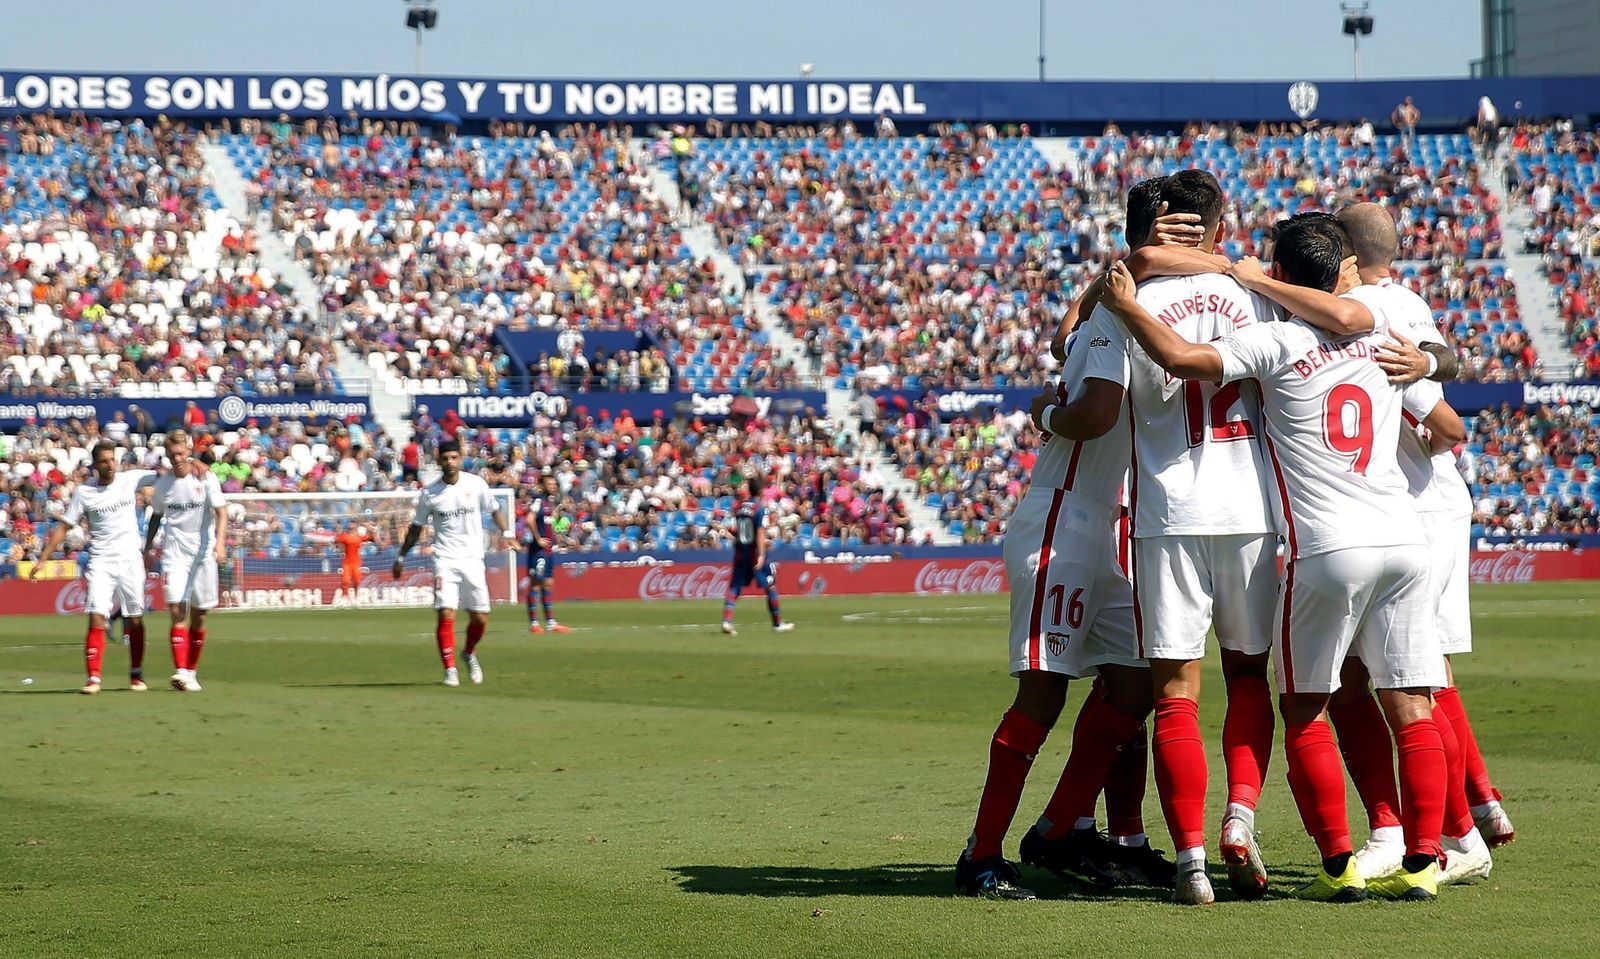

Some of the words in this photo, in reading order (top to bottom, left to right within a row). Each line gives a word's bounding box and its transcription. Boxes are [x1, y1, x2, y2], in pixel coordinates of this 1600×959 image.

[144, 77, 235, 110] SON
[248, 78, 329, 111] LOS
[340, 73, 446, 112] MÍOS
[457, 81, 486, 114] Y
[497, 83, 552, 115] TU
[565, 83, 738, 115] NOMBRE
[749, 83, 795, 115] MI
[806, 83, 926, 115] IDEAL
[1158, 291, 1203, 329] NDRÉ
[1293, 343, 1333, 380] BEN
[247, 402, 309, 418] Levante
[1182, 378, 1256, 448] 12
[1322, 383, 1375, 477] 9
[1048, 583, 1085, 630] 16
